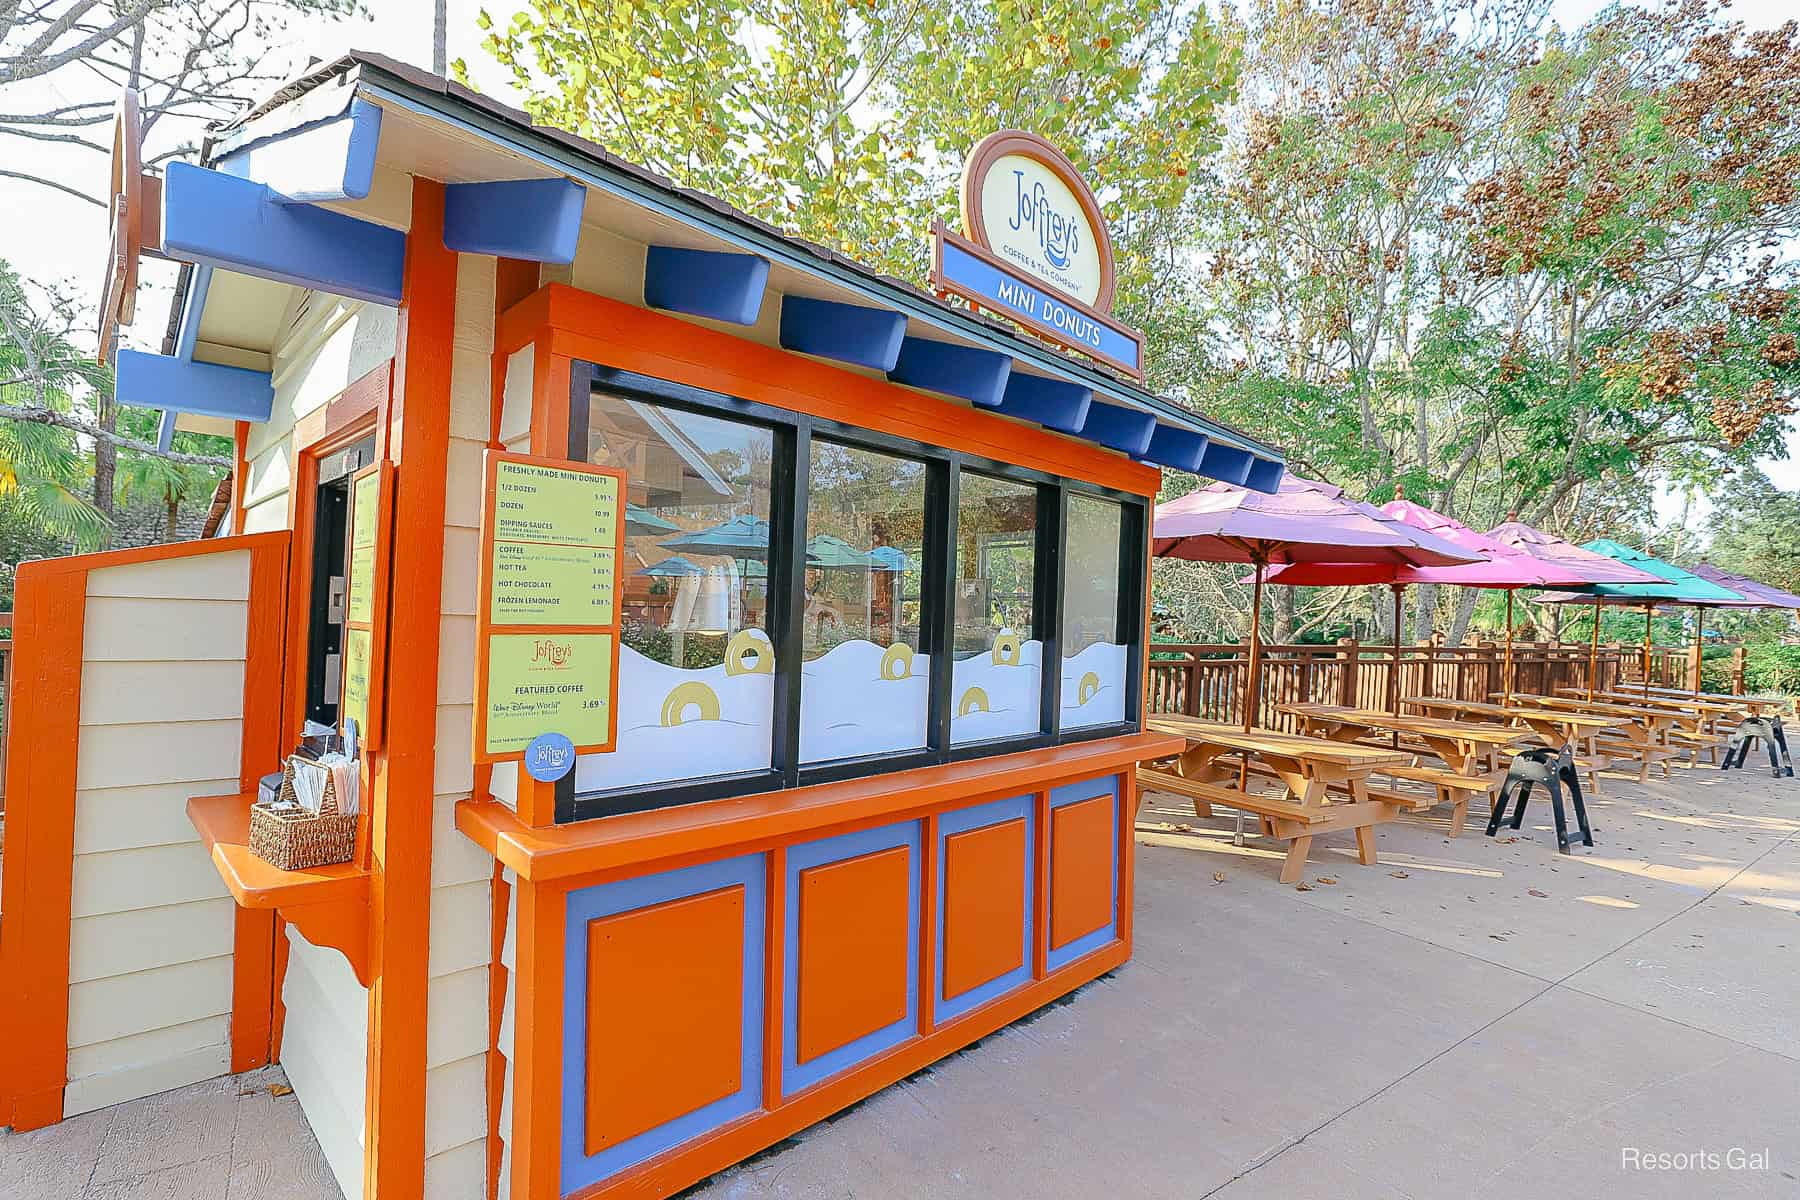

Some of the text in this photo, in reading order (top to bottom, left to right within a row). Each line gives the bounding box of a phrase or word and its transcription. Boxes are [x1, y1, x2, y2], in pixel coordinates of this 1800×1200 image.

[1008, 170, 1079, 262] Joffrey's
[1003, 244, 1029, 265] COFFEE
[1050, 271, 1079, 293] COMPANY
[998, 279, 1101, 346] MINI DONUTS
[503, 465, 607, 485] FRESHLY MADE MINI DONUTS
[513, 484, 537, 493] DOZEN
[500, 501, 524, 510] DOZEN
[500, 519, 528, 528] DIPPING
[529, 520, 553, 530] SAUCES
[499, 546, 524, 554] COFFEE
[514, 580, 552, 589] CHOCOLATE
[498, 596, 560, 605] FROZEN LEMONADE
[531, 640, 572, 665] Joffrey's
[515, 684, 584, 694] FEATURED COFFEE
